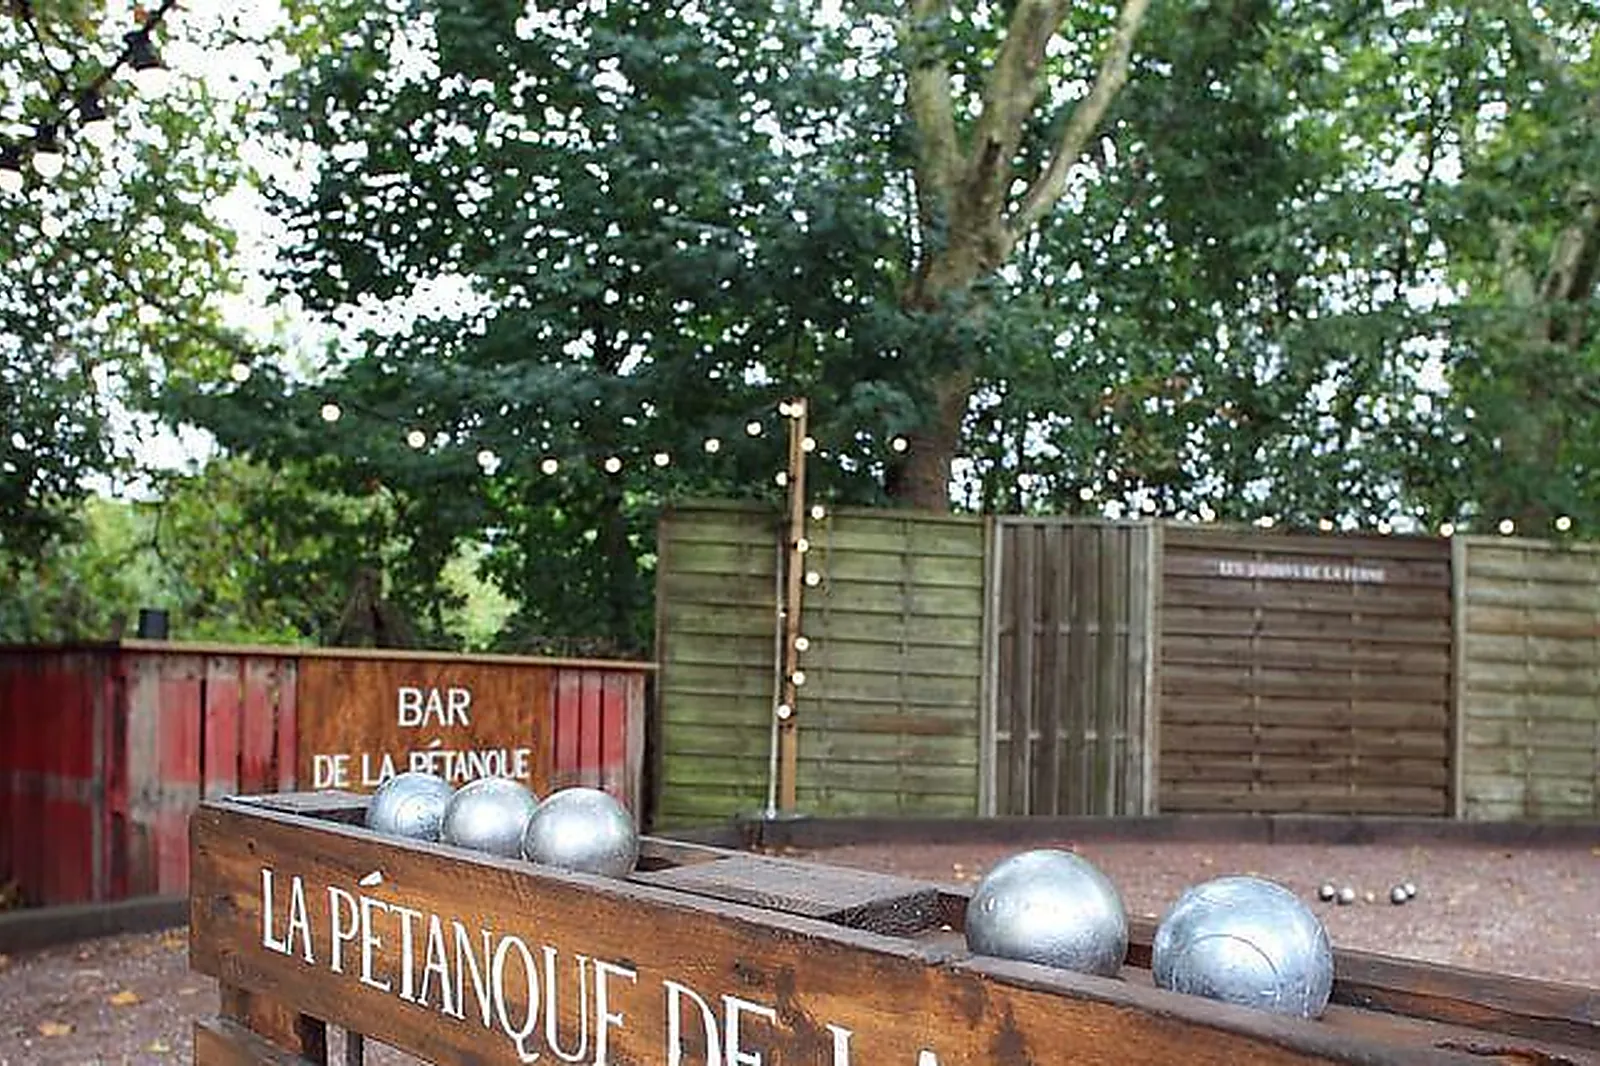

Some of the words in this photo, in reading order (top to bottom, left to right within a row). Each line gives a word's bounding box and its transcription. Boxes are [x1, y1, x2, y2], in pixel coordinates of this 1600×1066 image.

[398, 687, 472, 727] BAR
[313, 753, 350, 789] DE
[361, 752, 396, 787] LA
[408, 738, 532, 782] PÉTANQUE
[261, 868, 315, 966] LA
[327, 870, 638, 1066] PÉTANQUE
